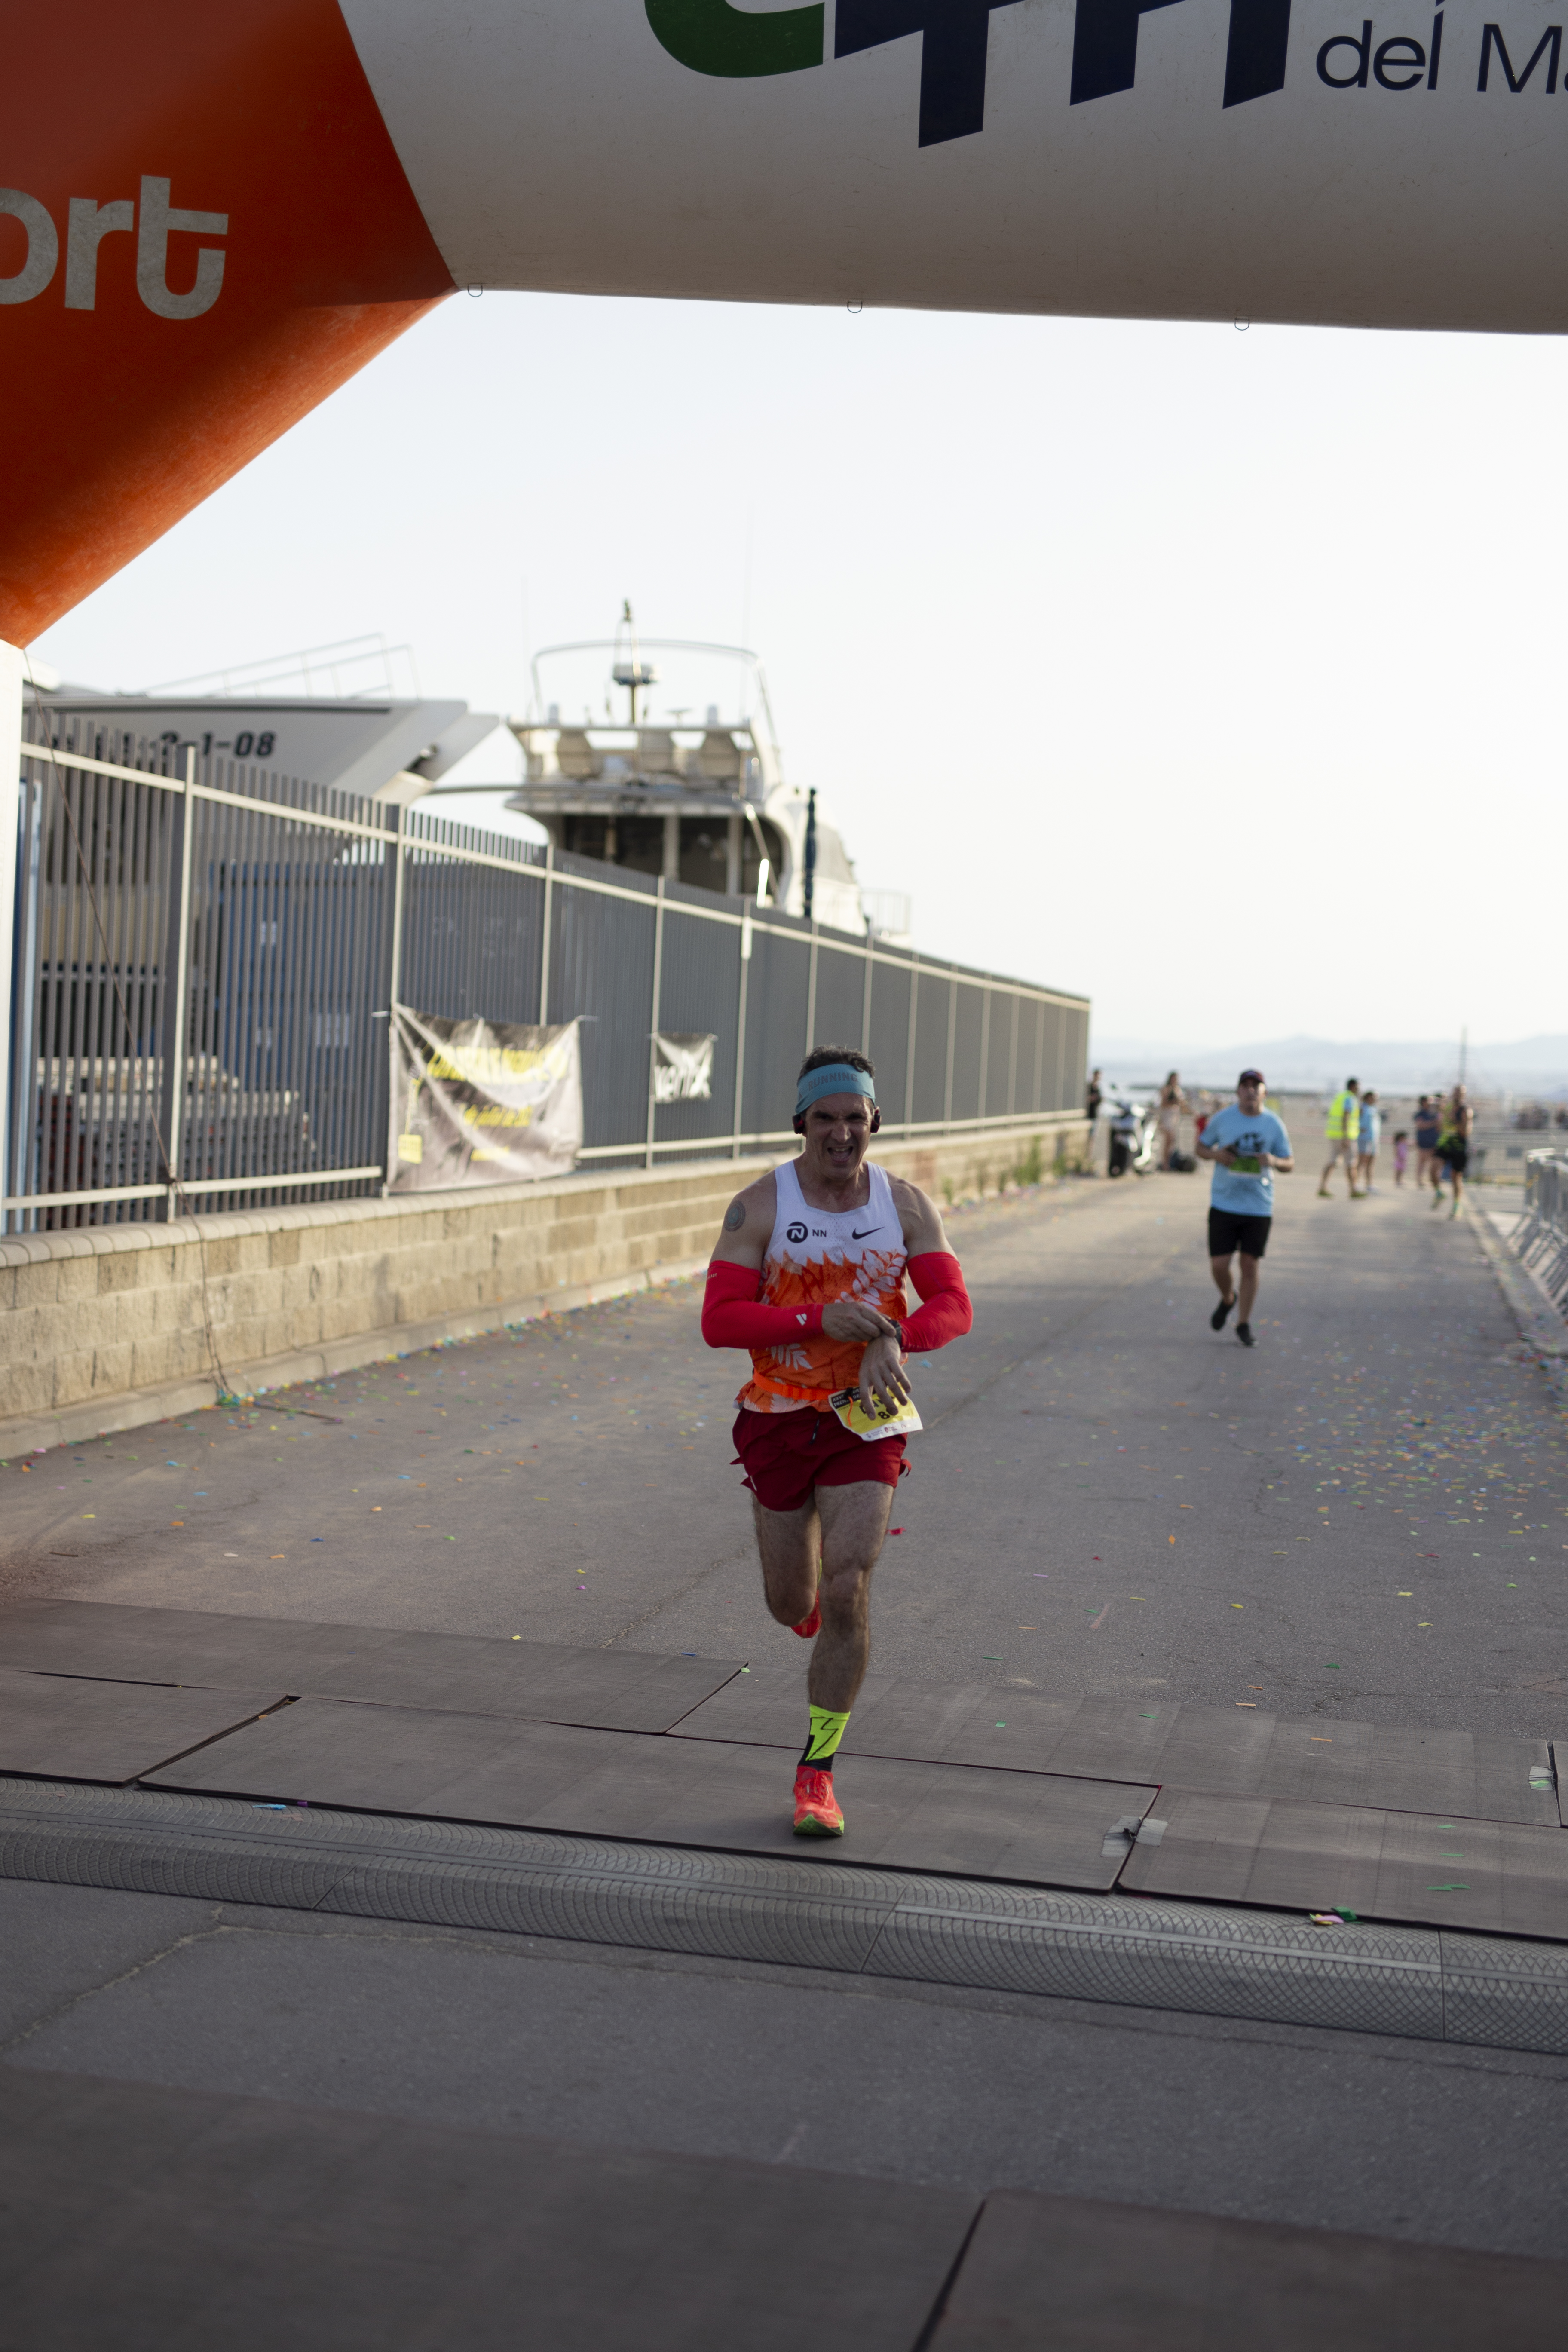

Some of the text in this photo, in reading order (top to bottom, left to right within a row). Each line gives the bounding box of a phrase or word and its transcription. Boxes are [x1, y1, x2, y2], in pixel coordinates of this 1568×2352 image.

[1477, 23, 1568, 95] M
[808, 1072, 858, 1091] RUNNING
[812, 1229, 827, 1237] NN
